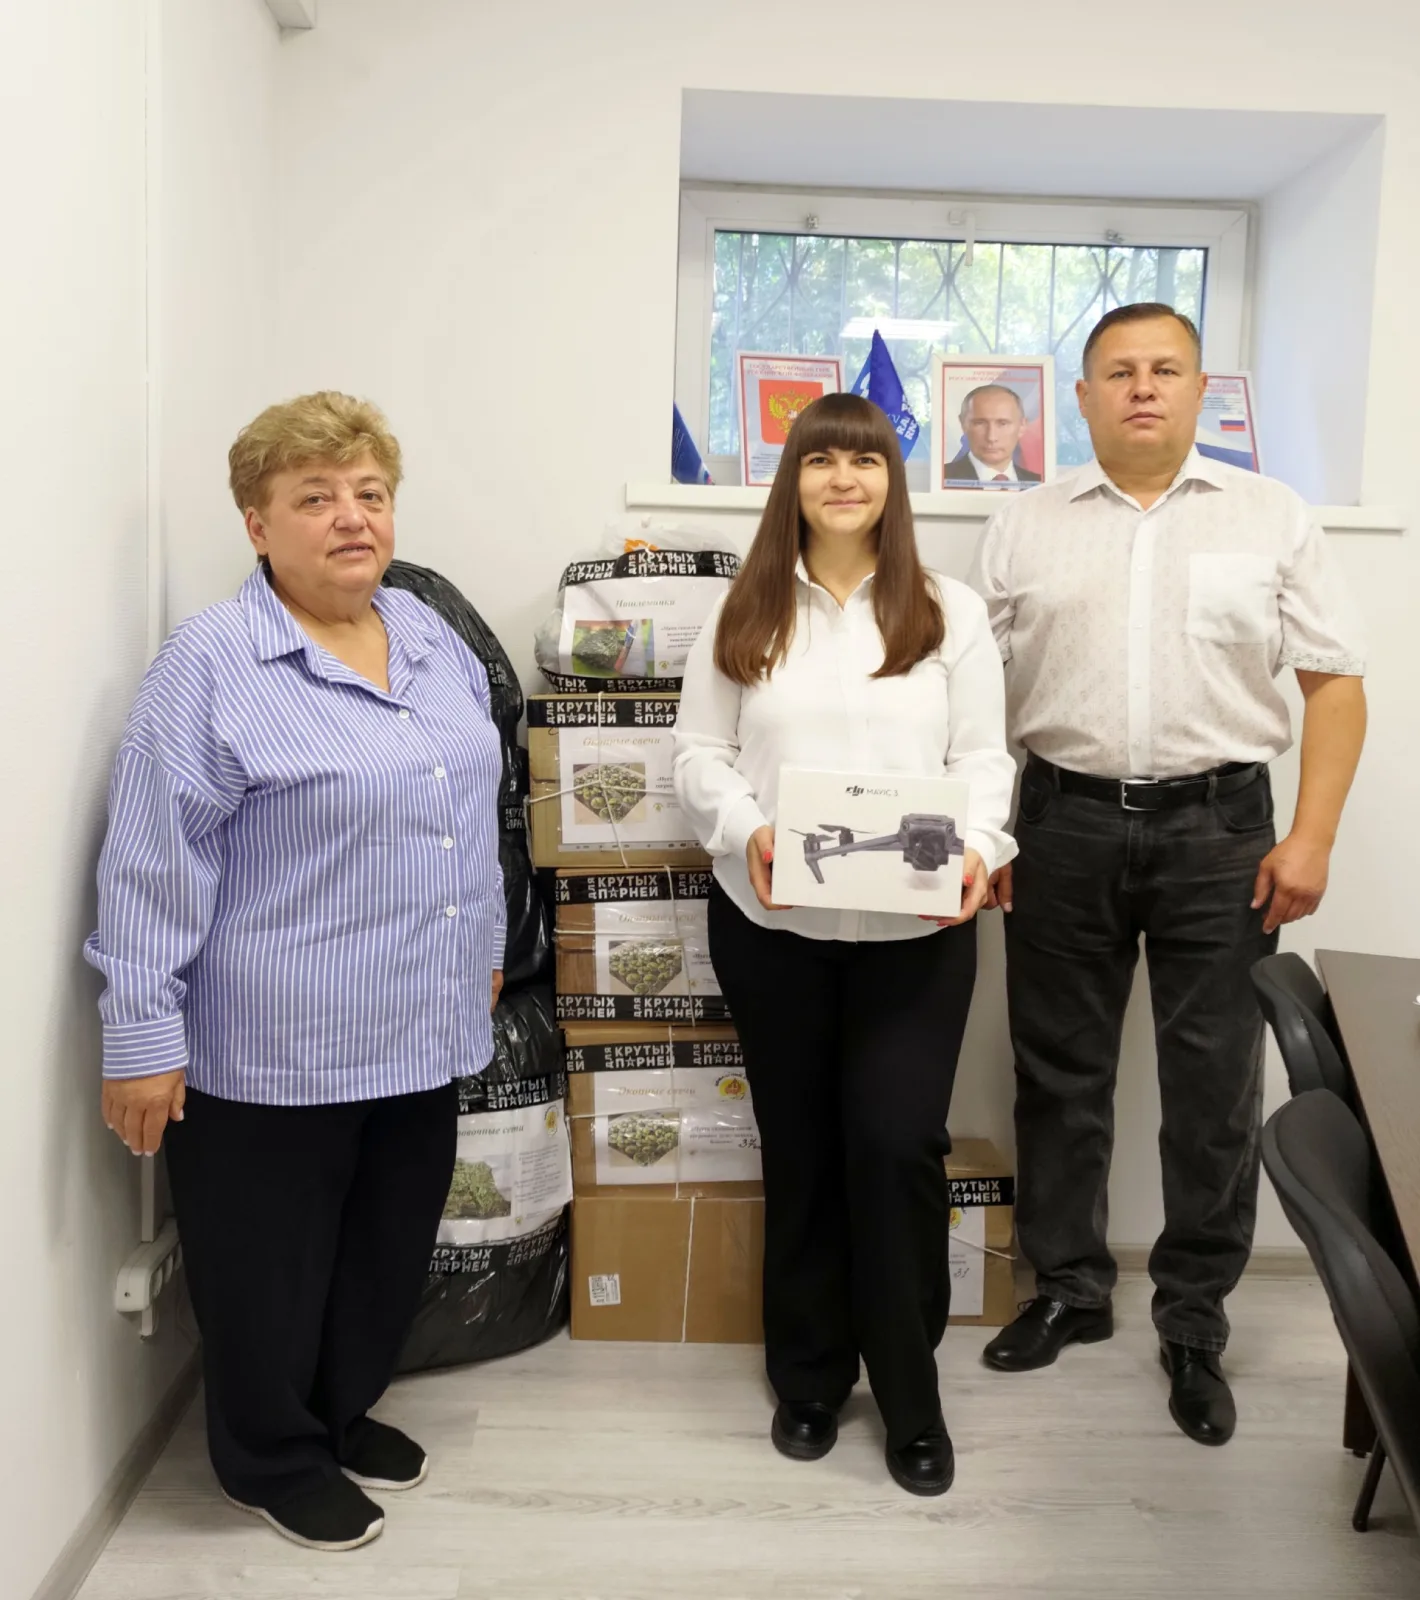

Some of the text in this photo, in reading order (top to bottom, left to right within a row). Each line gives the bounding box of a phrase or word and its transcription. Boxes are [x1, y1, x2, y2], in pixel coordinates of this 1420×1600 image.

[638, 552, 696, 564] КРУТЫХ
[568, 561, 615, 575] РУТЫХ
[556, 701, 616, 713] КРУТЫХ
[867, 788, 892, 797] MAVIC
[598, 875, 658, 888] КРУТЫХ
[556, 996, 615, 1008] КРУТЫХ
[644, 997, 704, 1008] КРУТЫХ
[615, 1044, 674, 1057] КРУТЫХ
[497, 1077, 547, 1097] КРУТЫХ
